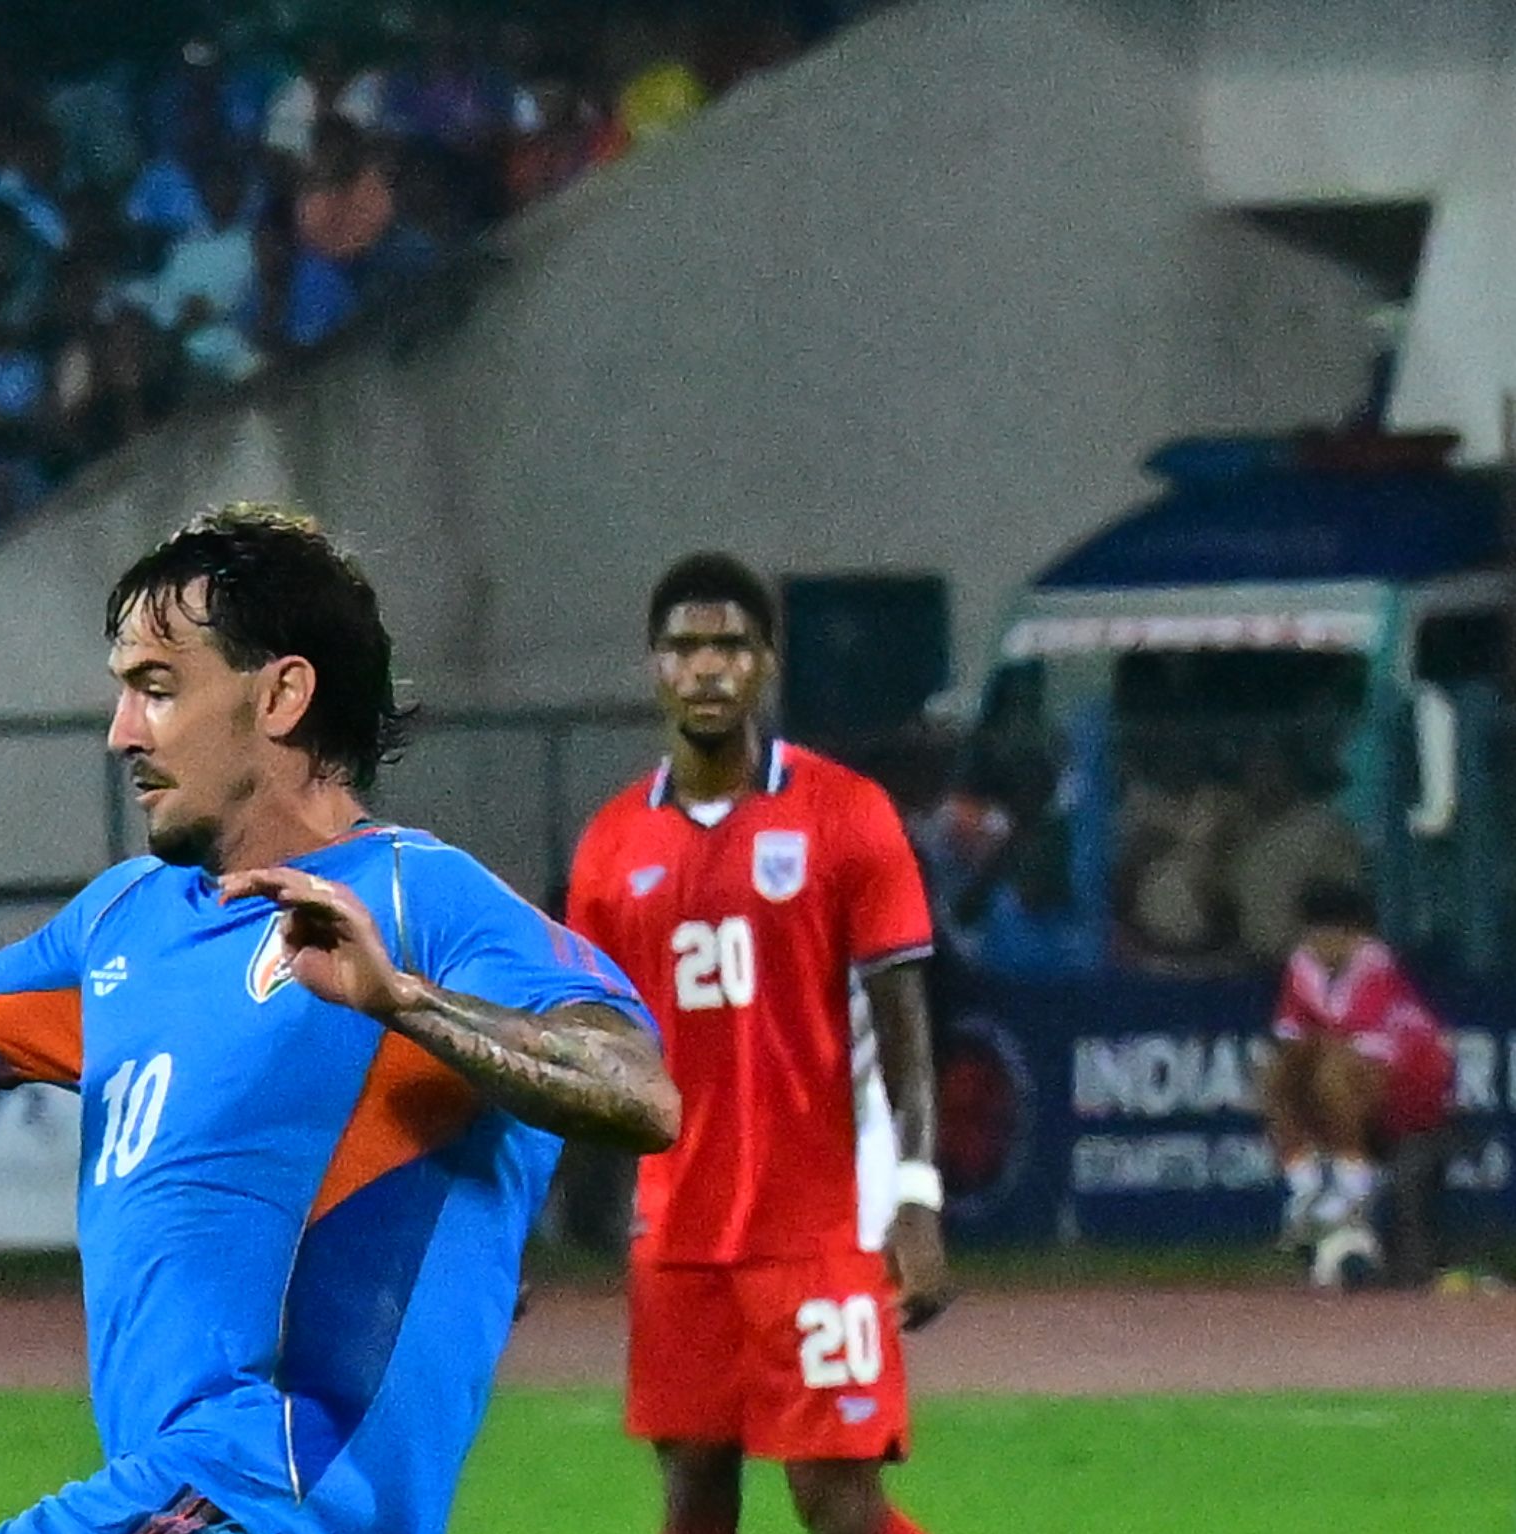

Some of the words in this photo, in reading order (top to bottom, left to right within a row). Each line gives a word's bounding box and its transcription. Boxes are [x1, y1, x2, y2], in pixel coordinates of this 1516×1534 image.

[671, 916, 755, 1010] 20
[94, 1053, 172, 1186] 10
[796, 1295, 882, 1389] 20
